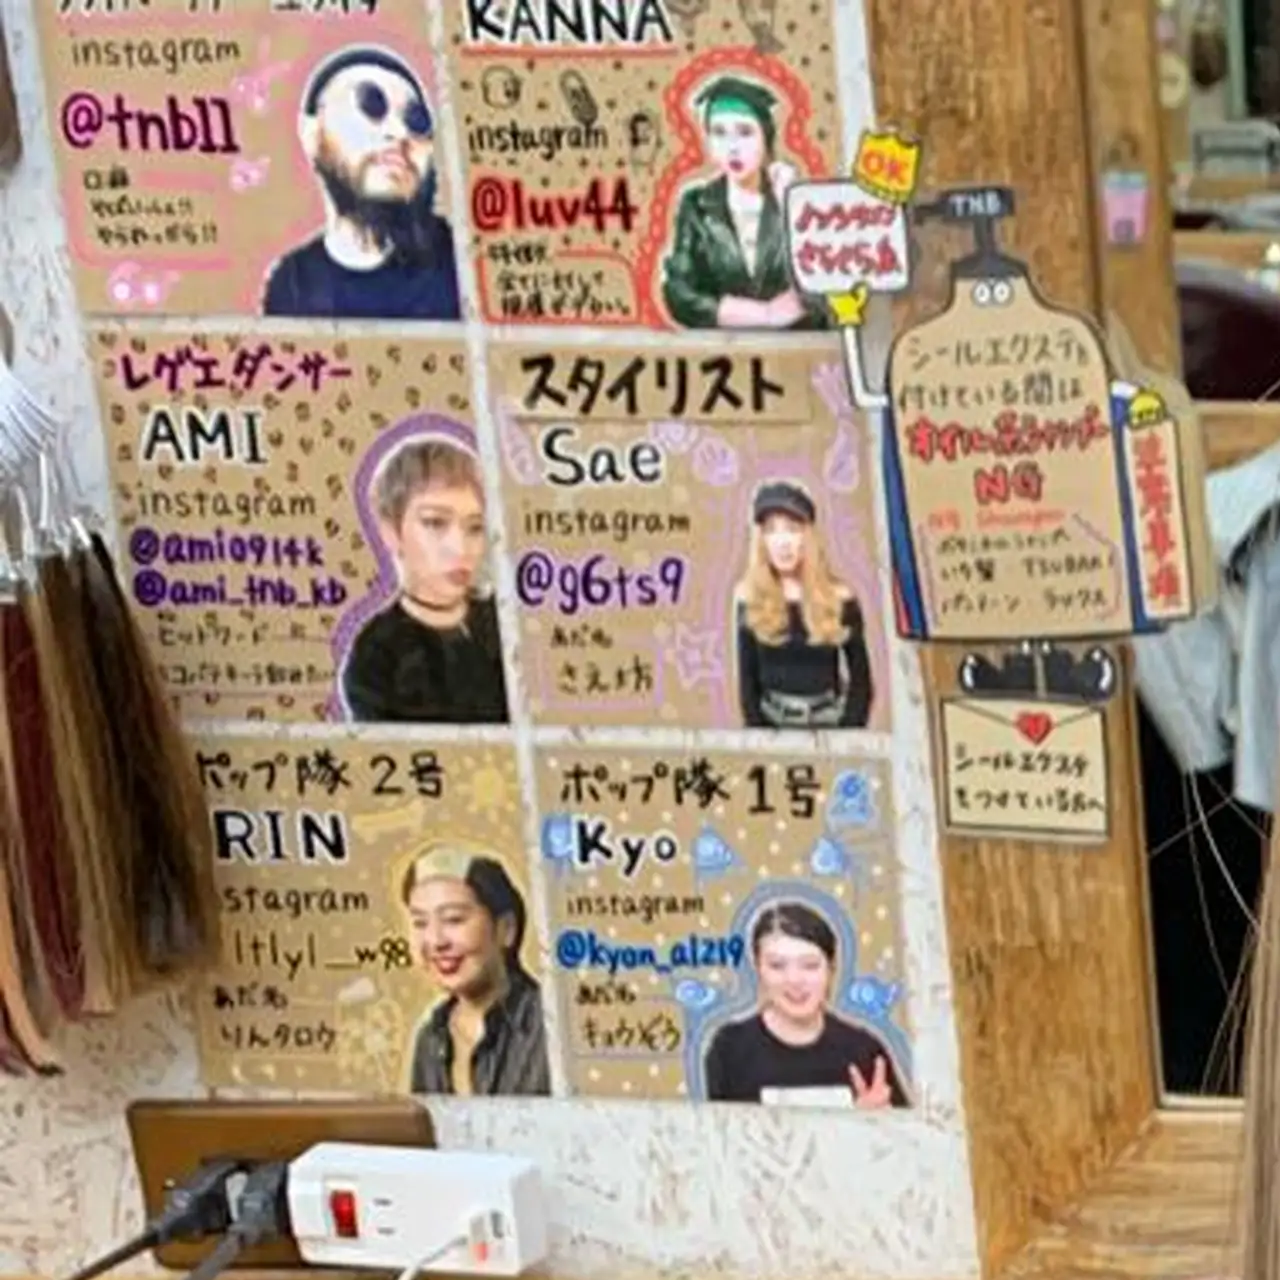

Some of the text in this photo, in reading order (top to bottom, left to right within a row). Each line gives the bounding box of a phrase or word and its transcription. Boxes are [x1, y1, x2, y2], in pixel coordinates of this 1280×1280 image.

[467, 0, 674, 42] KANNA
[71, 34, 240, 74] instagram
[467, 116, 608, 160] instagram
[862, 150, 910, 186] OK
[471, 178, 638, 232] @luv44
[120, 344, 352, 392] レゲエダンサー
[521, 354, 785, 416] スタイリスト
[142, 410, 268, 464] AMI
[542, 427, 662, 487] Sae
[972, 459, 1044, 504] NG
[138, 487, 317, 524] instagram
[525, 500, 691, 540] instagram
[213, 809, 346, 861] RIN
[576, 820, 678, 877] Kyo
[223, 886, 370, 918] stagram
[566, 890, 705, 925] instagram
